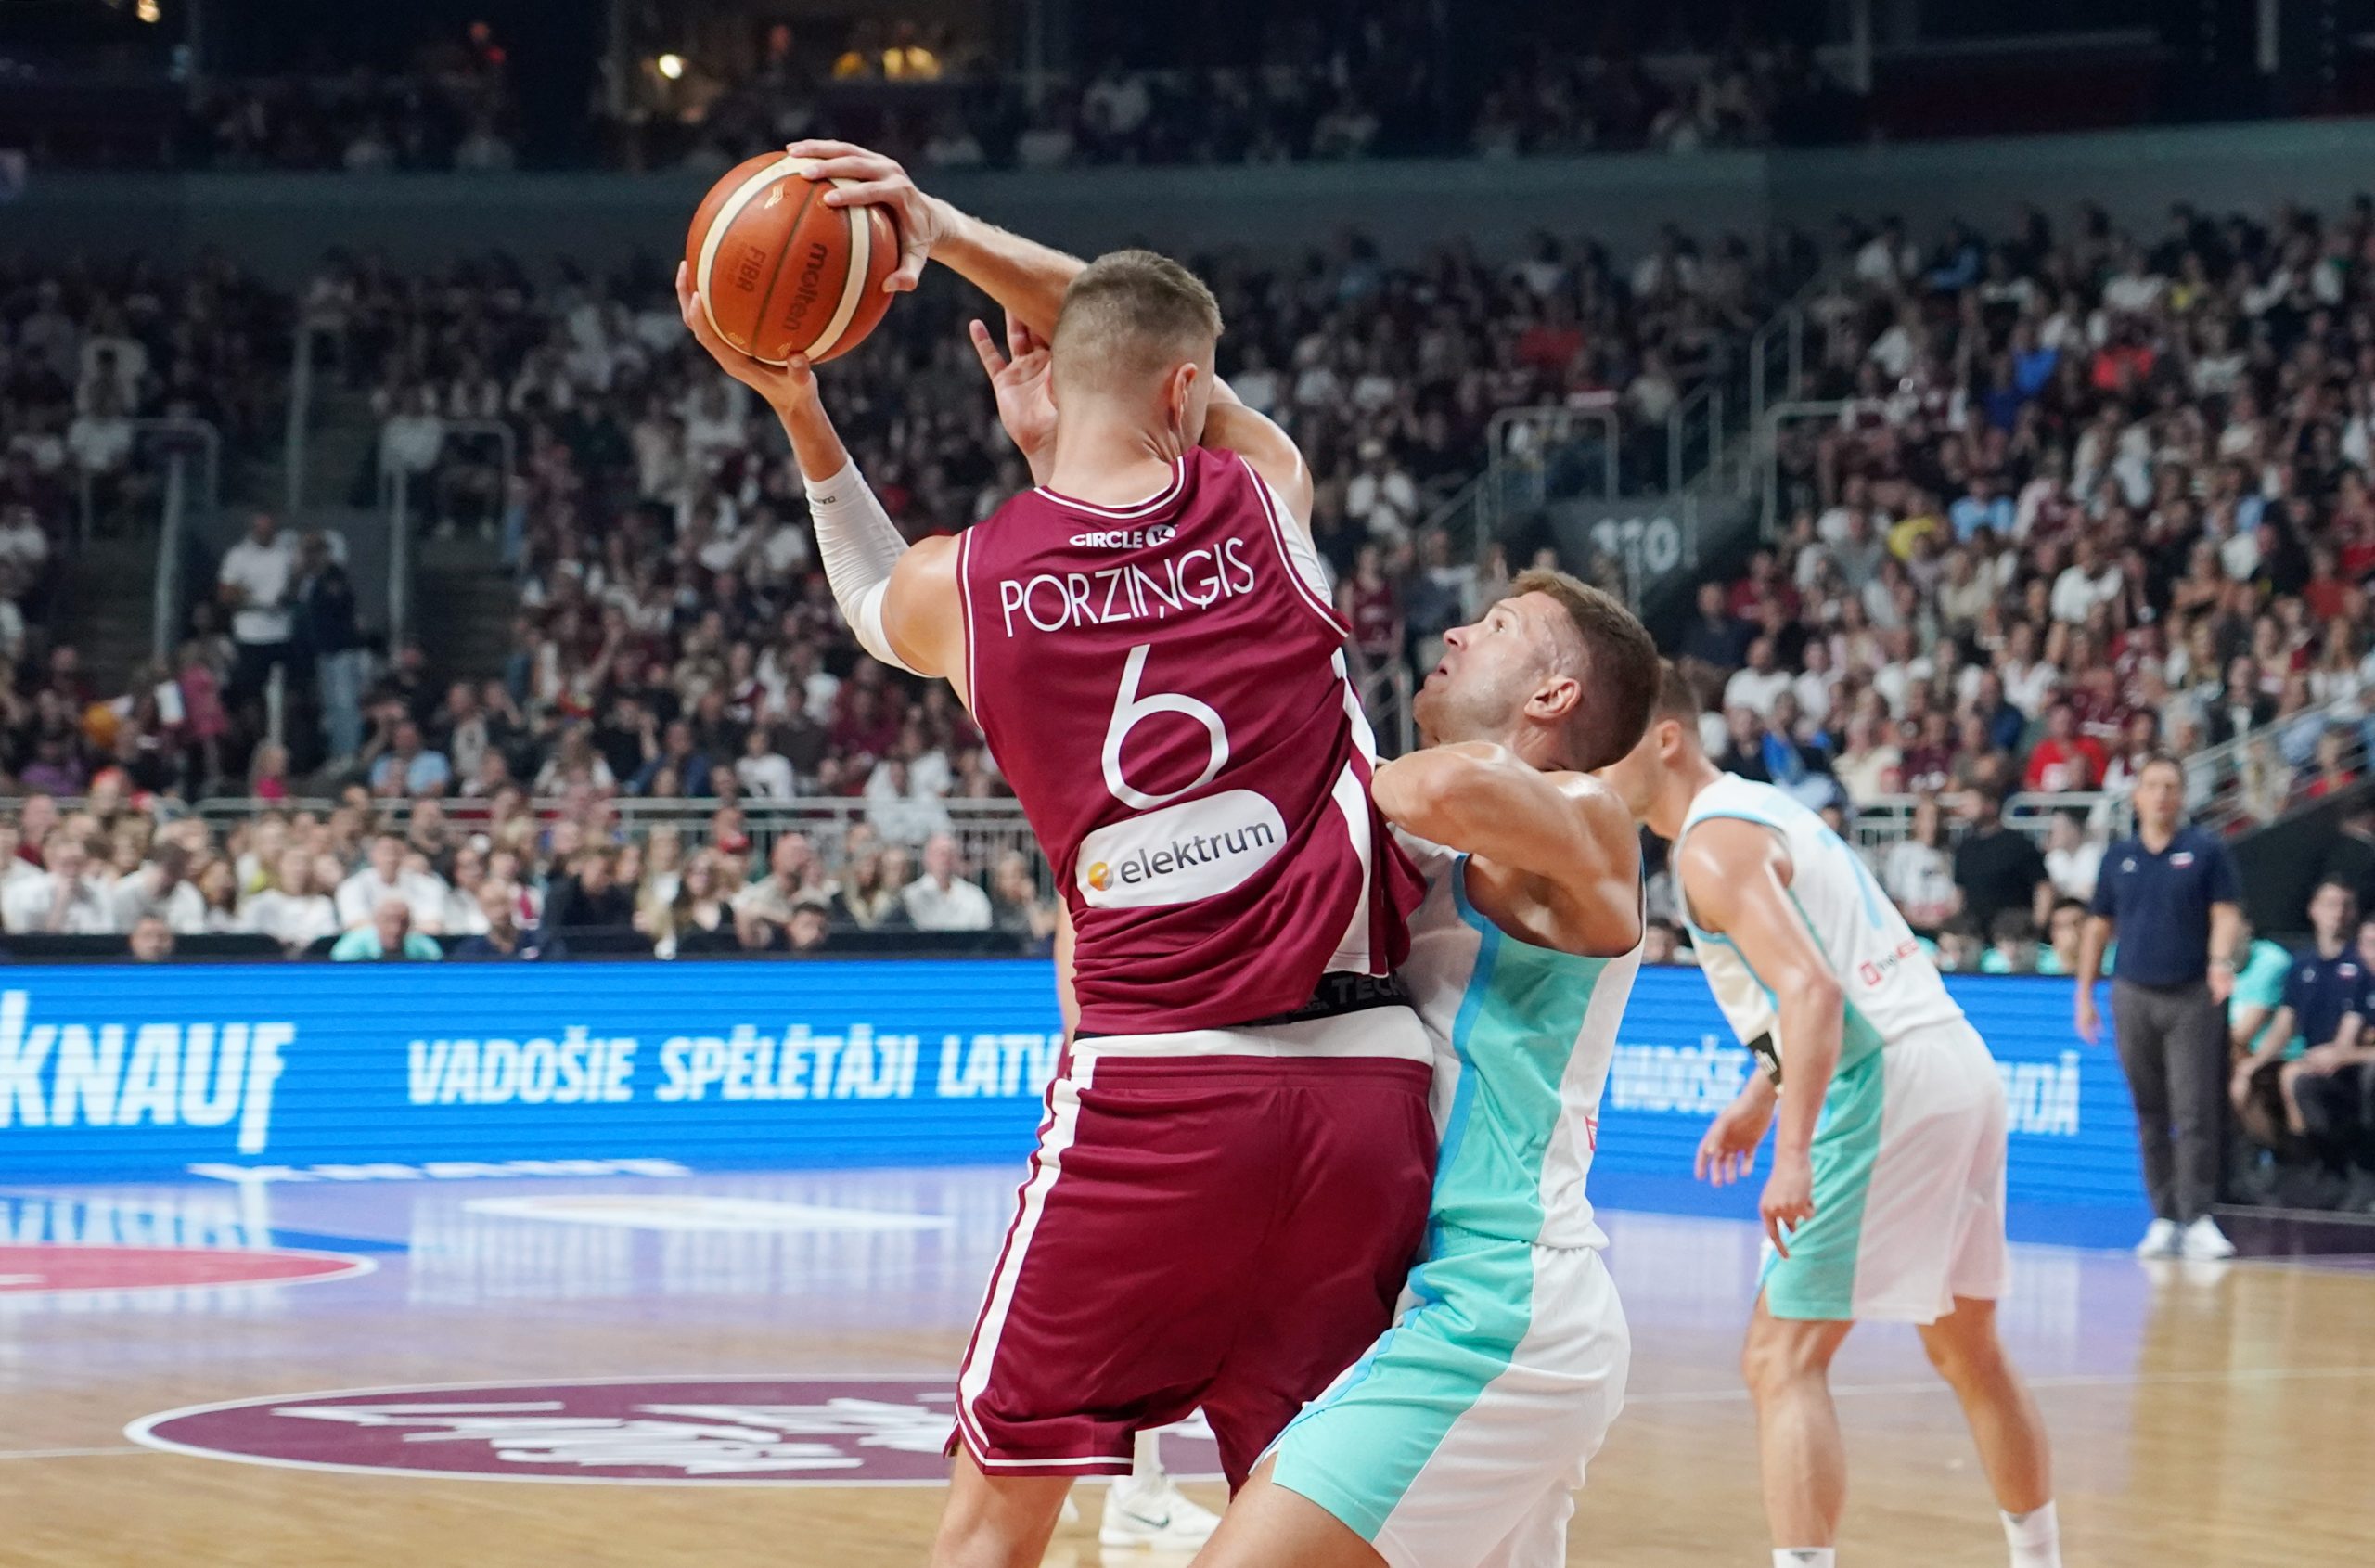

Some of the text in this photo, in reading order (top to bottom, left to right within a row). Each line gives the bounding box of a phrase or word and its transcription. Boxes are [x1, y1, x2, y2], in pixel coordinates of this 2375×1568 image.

[736, 245, 766, 293] FIBA
[782, 242, 828, 330] molten
[1069, 530, 1143, 548] CIRCLE
[1101, 643, 1229, 810] 6
[1120, 821, 1275, 884] elektrum
[0, 988, 296, 1154] KNAUF
[407, 1025, 637, 1104] VADOŠIE
[655, 1023, 919, 1101] SPĒLĒTĀJI
